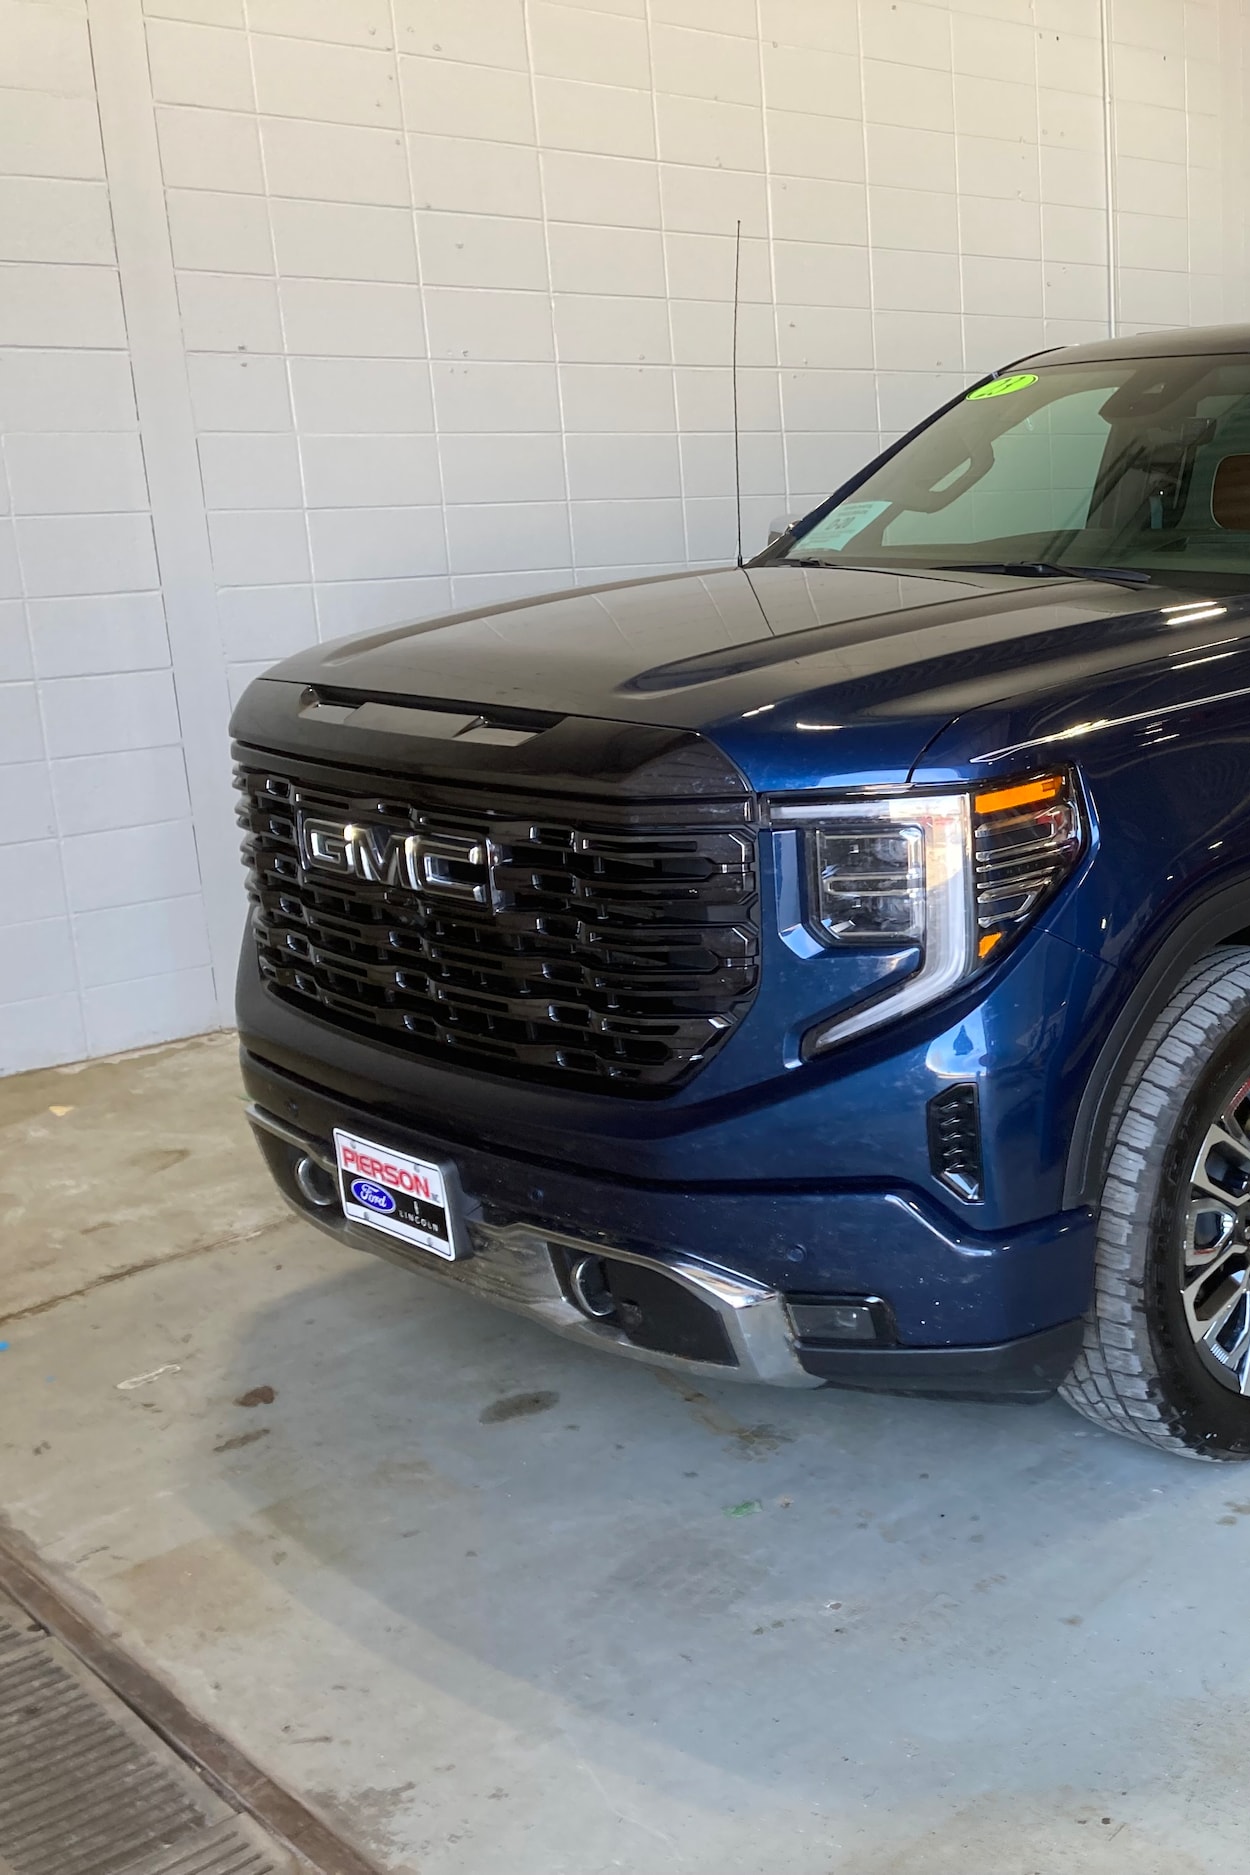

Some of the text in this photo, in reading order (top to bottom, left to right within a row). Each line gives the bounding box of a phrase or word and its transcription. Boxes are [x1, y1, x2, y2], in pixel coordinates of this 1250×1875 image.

[303, 818, 487, 903] GMC
[341, 1146, 431, 1198] PIERSON
[359, 1183, 388, 1208] Ford
[398, 1208, 439, 1232] LINCOLN
